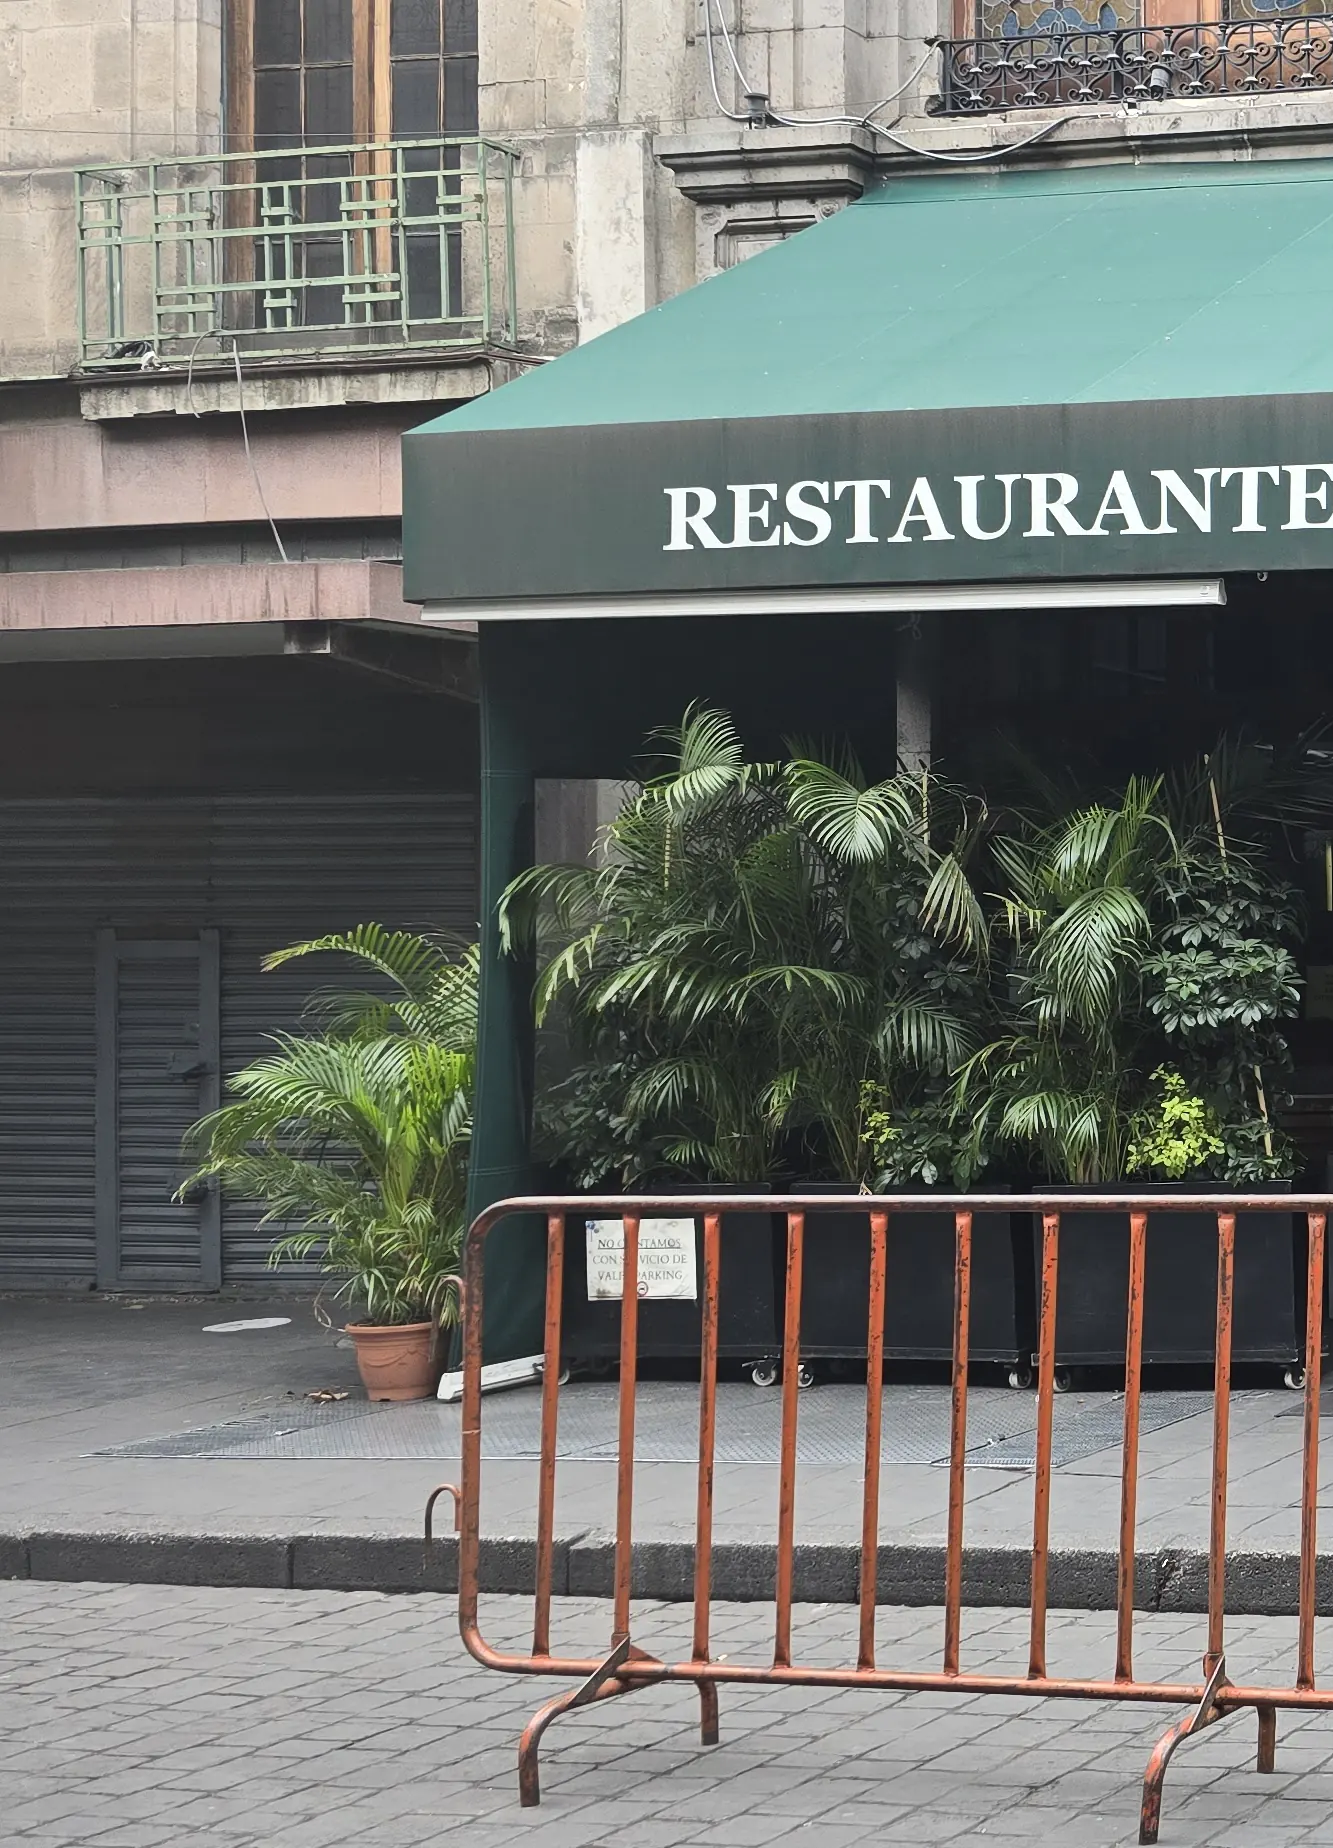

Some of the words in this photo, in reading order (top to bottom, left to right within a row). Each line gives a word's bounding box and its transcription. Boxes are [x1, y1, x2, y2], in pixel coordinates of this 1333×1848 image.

[598, 1239, 615, 1248] NO
[617, 1238, 681, 1248] CNTAMOS
[593, 1255, 617, 1265] CON
[620, 1254, 670, 1265] SVICIO
[673, 1254, 688, 1264] DE
[638, 1270, 683, 1281] ARKING
